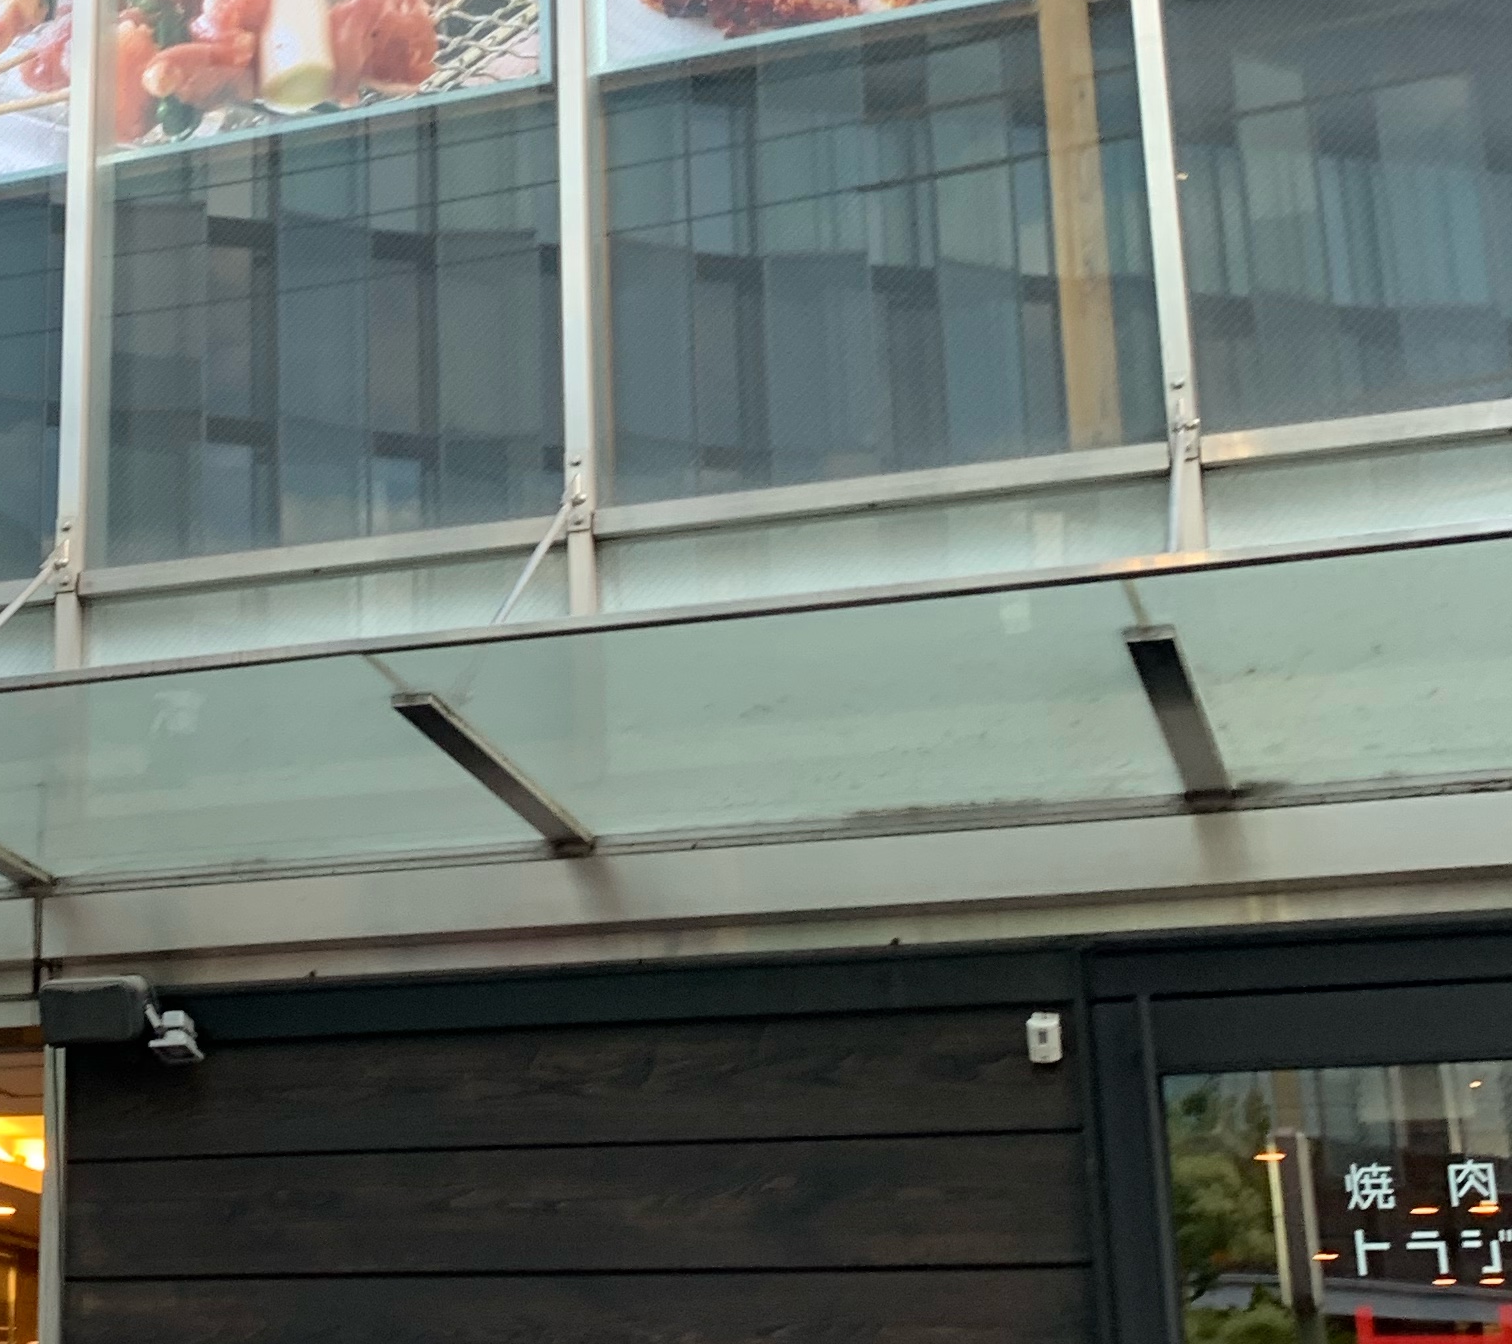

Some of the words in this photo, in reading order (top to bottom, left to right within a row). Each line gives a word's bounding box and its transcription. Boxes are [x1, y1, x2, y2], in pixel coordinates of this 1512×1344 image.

[1344, 1159, 1498, 1211] 焼肉
[1353, 1228, 1512, 1277] トラジ
